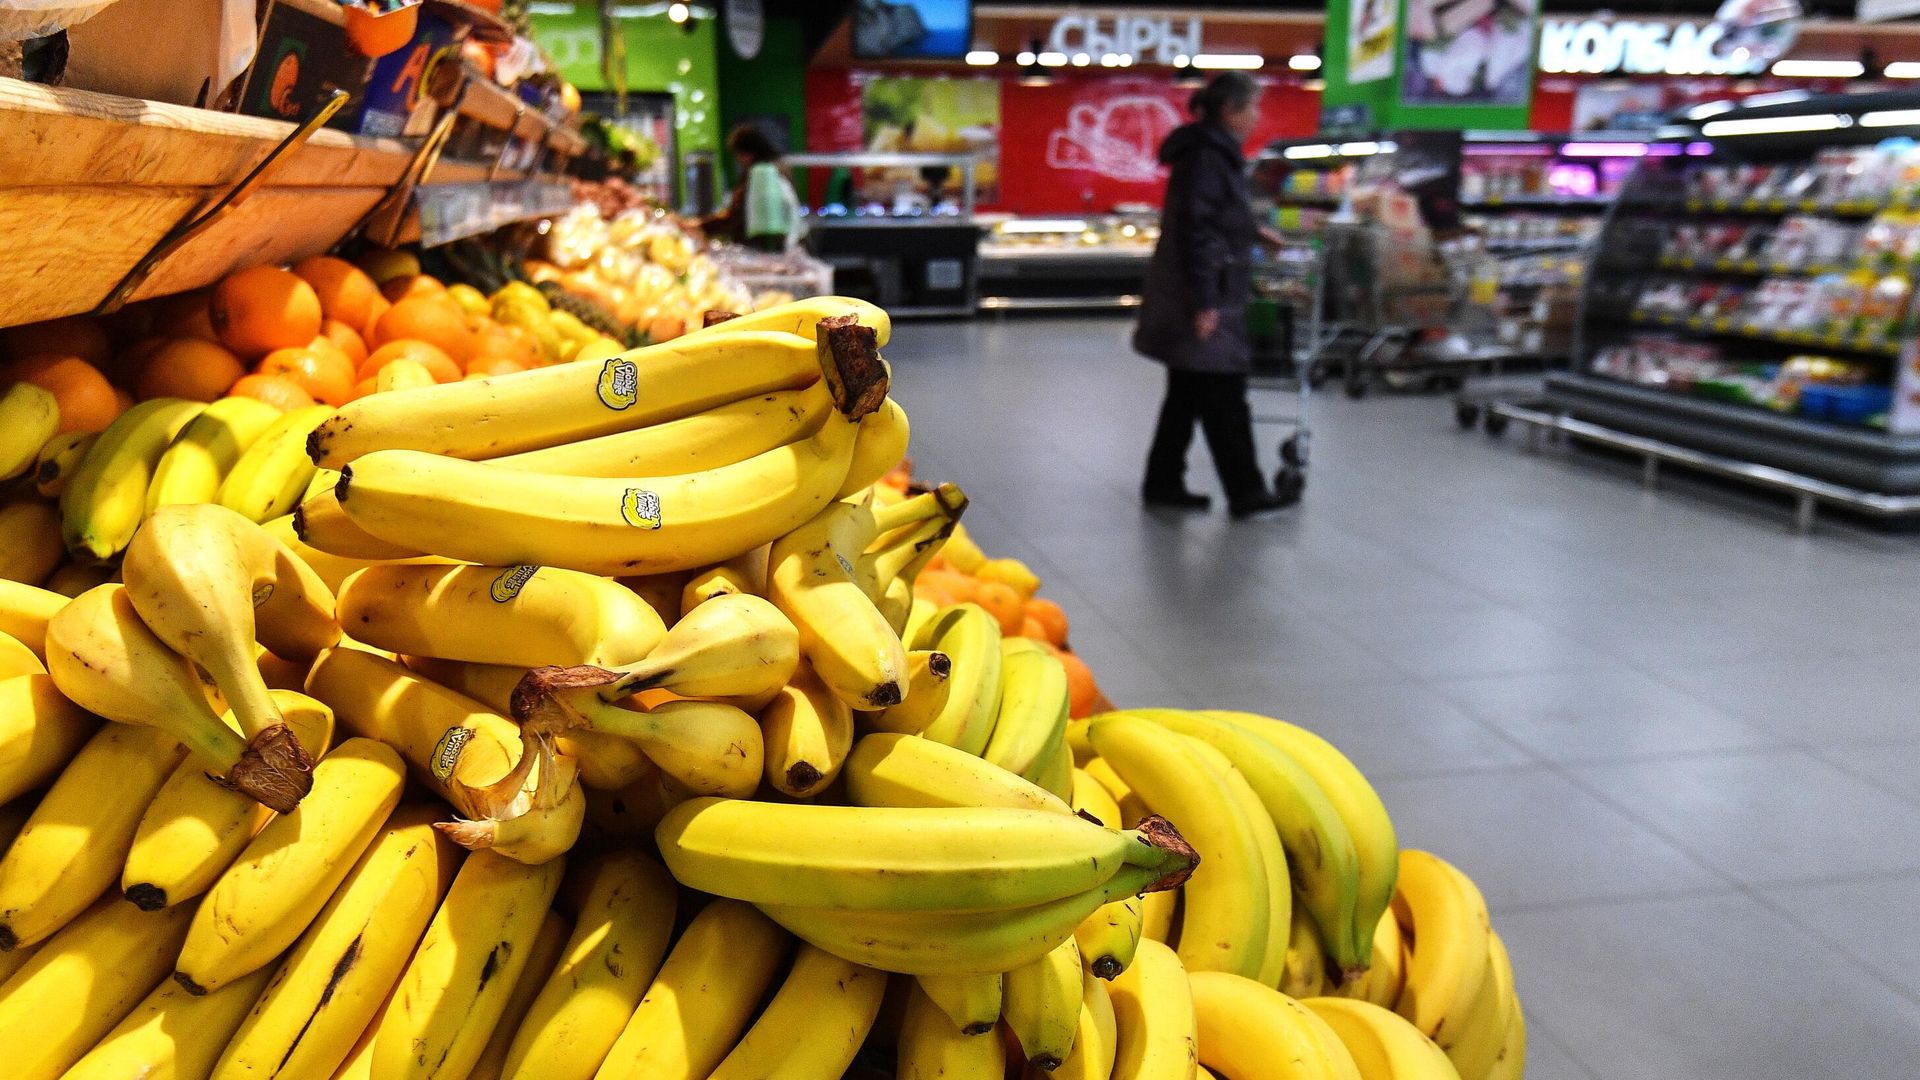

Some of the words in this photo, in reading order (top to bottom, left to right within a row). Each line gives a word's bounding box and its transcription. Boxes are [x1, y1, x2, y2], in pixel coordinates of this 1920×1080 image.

[1050, 16, 1203, 66] СЫРЫ
[1539, 20, 1768, 75] КОЛБАС
[613, 366, 625, 395] Village
